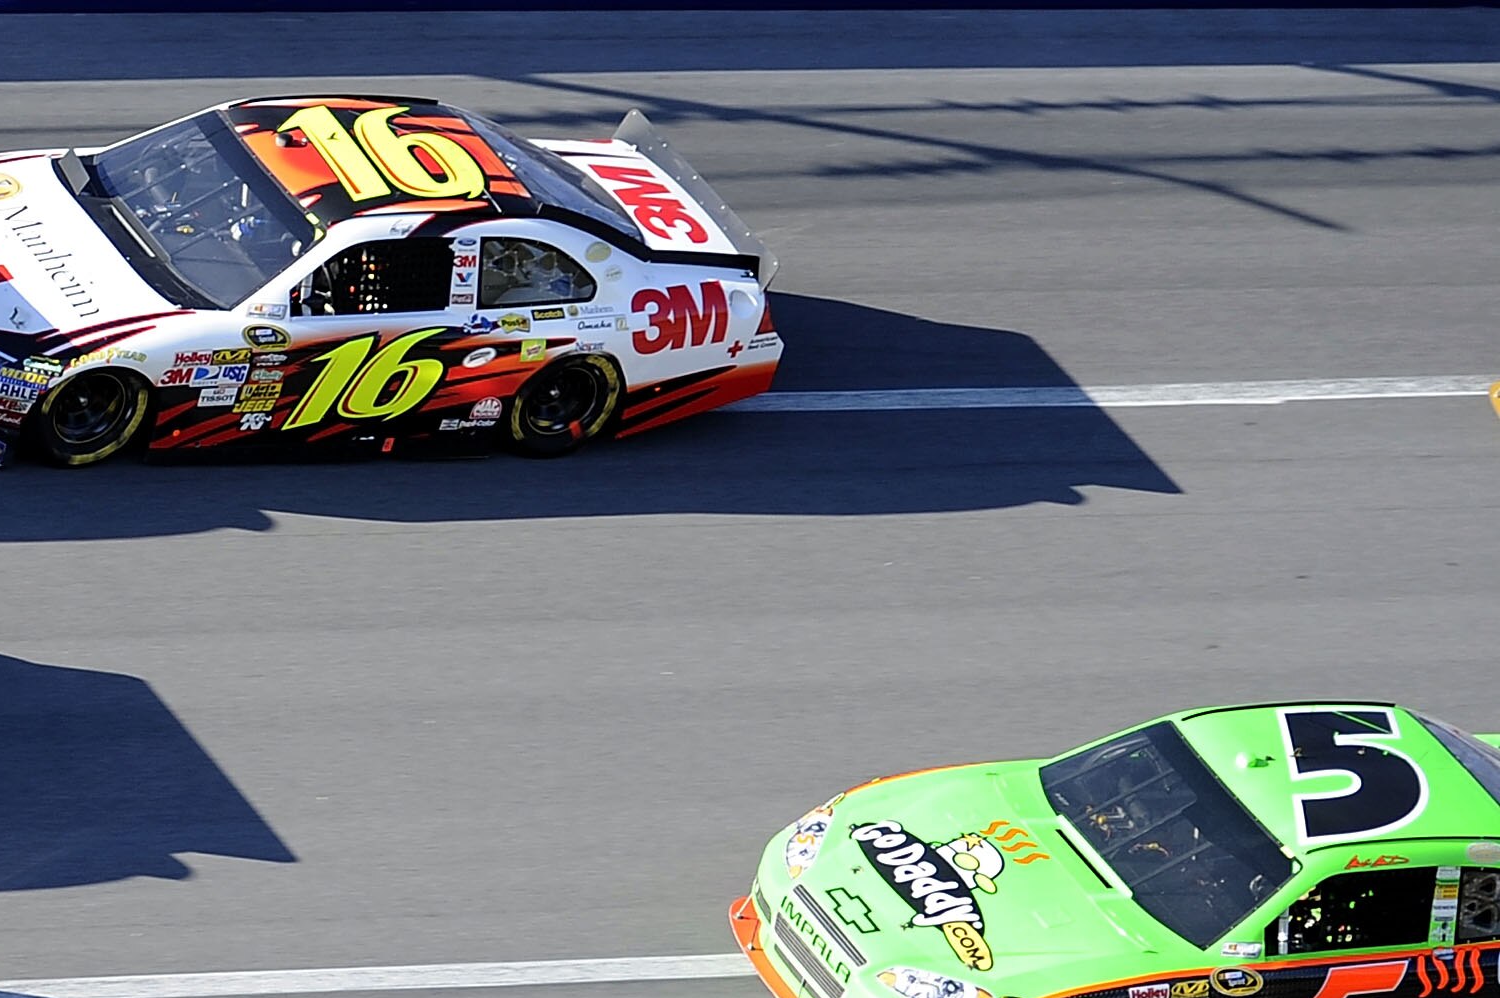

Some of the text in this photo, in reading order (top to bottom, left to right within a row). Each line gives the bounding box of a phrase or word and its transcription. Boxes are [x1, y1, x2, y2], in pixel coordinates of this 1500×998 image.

[277, 105, 484, 201] 16
[590, 163, 709, 245] 3M
[453, 255, 477, 268] 3M
[533, 310, 563, 319] Scotch
[630, 280, 729, 355] 3M
[175, 351, 212, 365] Holley
[0, 366, 51, 385] MOOG
[160, 367, 193, 385] 3M
[222, 365, 247, 382] USG
[281, 328, 449, 432] 16
[201, 394, 235, 403] TISSOT
[233, 399, 276, 413] JEGS
[1276, 706, 1431, 847] 5
[781, 895, 851, 984] IMPALA
